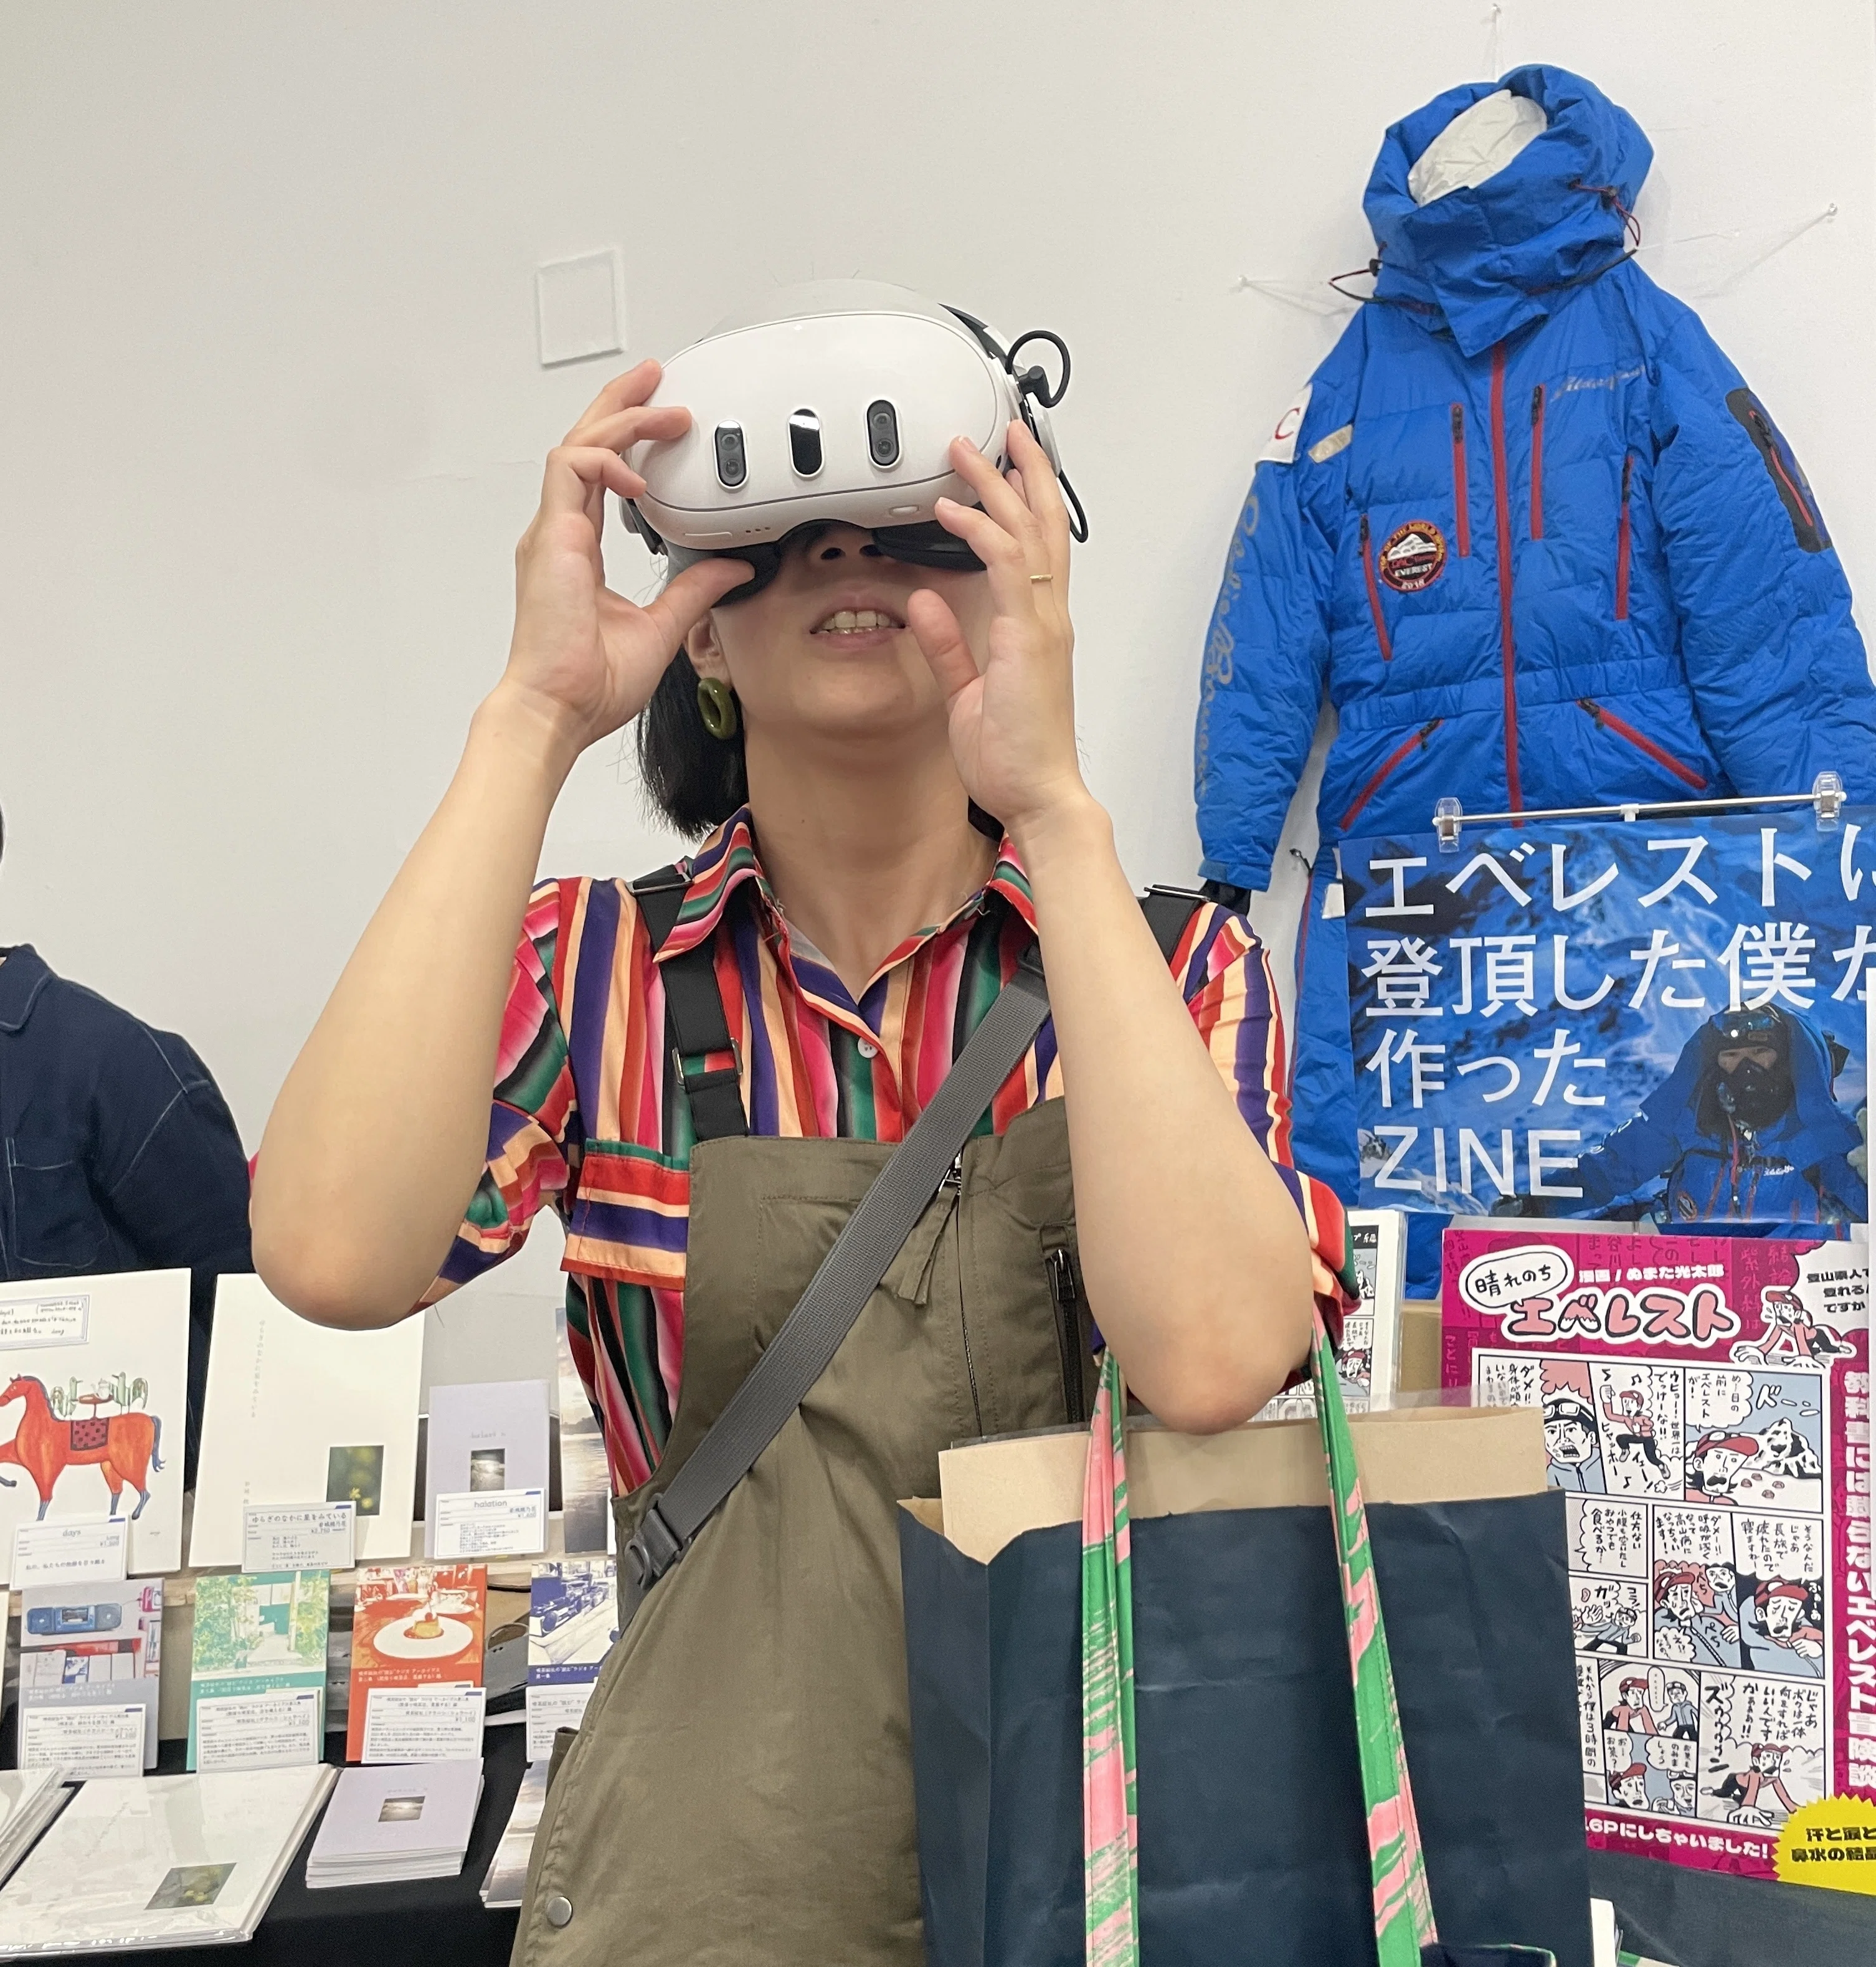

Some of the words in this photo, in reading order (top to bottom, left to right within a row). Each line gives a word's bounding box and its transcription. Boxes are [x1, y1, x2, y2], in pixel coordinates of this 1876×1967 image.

[1395, 562, 1433, 577] EVEREST
[1366, 1028, 1607, 1109] 作った
[1374, 1126, 1584, 1198] ZINE
[1475, 1264, 1551, 1297] 晴れのち
[1824, 1284, 1869, 1298] 登れる
[1507, 1289, 1735, 1342] エベレスト
[1701, 1373, 1713, 1419] エベレスト
[1716, 1375, 1727, 1396] 前に
[252, 1512, 347, 1523] ゆらぎのなかに星をみている
[474, 1500, 508, 1508] halation
[62, 1529, 82, 1538] days
[1630, 1510, 1642, 1550] 仕方ない
[1789, 1525, 1800, 1553] じゃあ
[1759, 1685, 1776, 1742] いいんです
[1805, 1689, 1819, 1729] じゃあ
